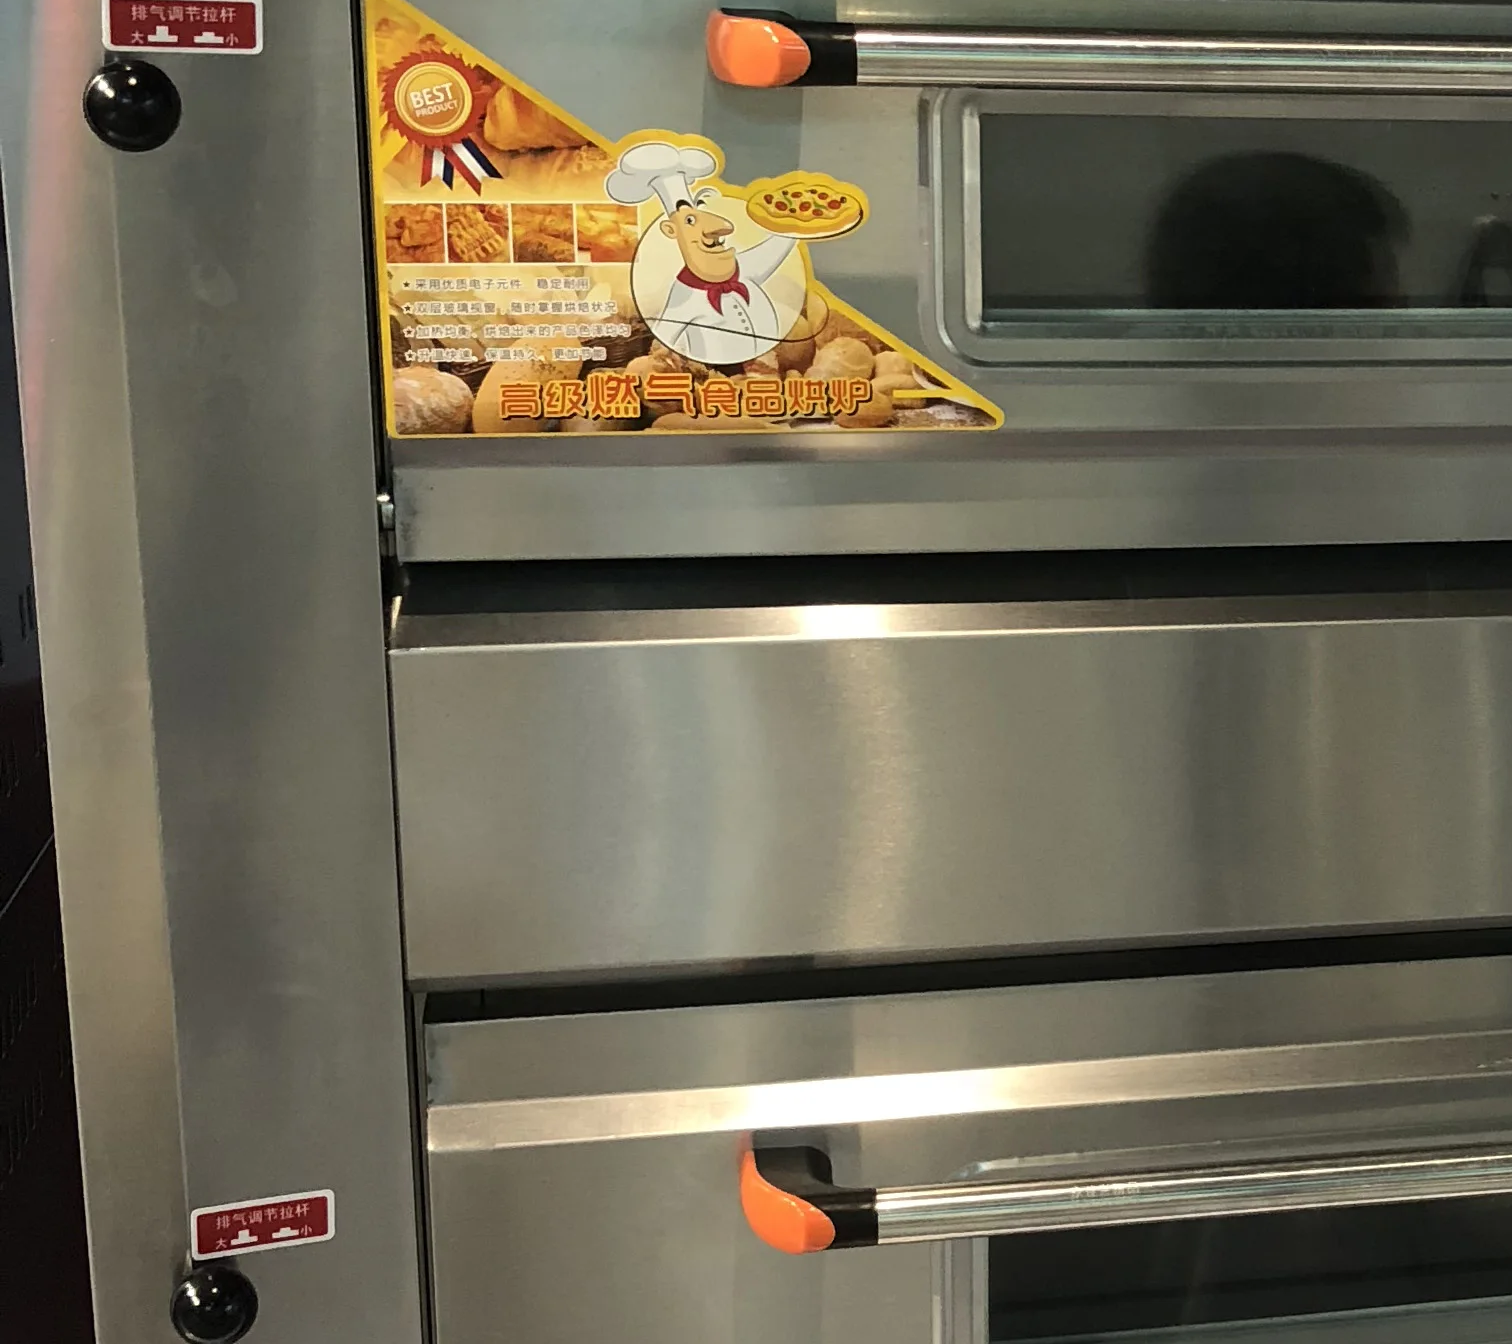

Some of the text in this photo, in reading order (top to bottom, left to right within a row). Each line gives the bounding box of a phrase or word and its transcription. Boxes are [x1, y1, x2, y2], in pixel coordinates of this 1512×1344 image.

[131, 4, 237, 24] 排气调节拉杆
[131, 30, 239, 47] 大 小
[409, 82, 453, 109] BEST
[415, 99, 459, 118] PRODUCT
[499, 373, 873, 420] 高级燃气食品烘炉
[216, 1203, 310, 1230] 排气调节拉杆
[215, 1224, 312, 1250] 大 小
